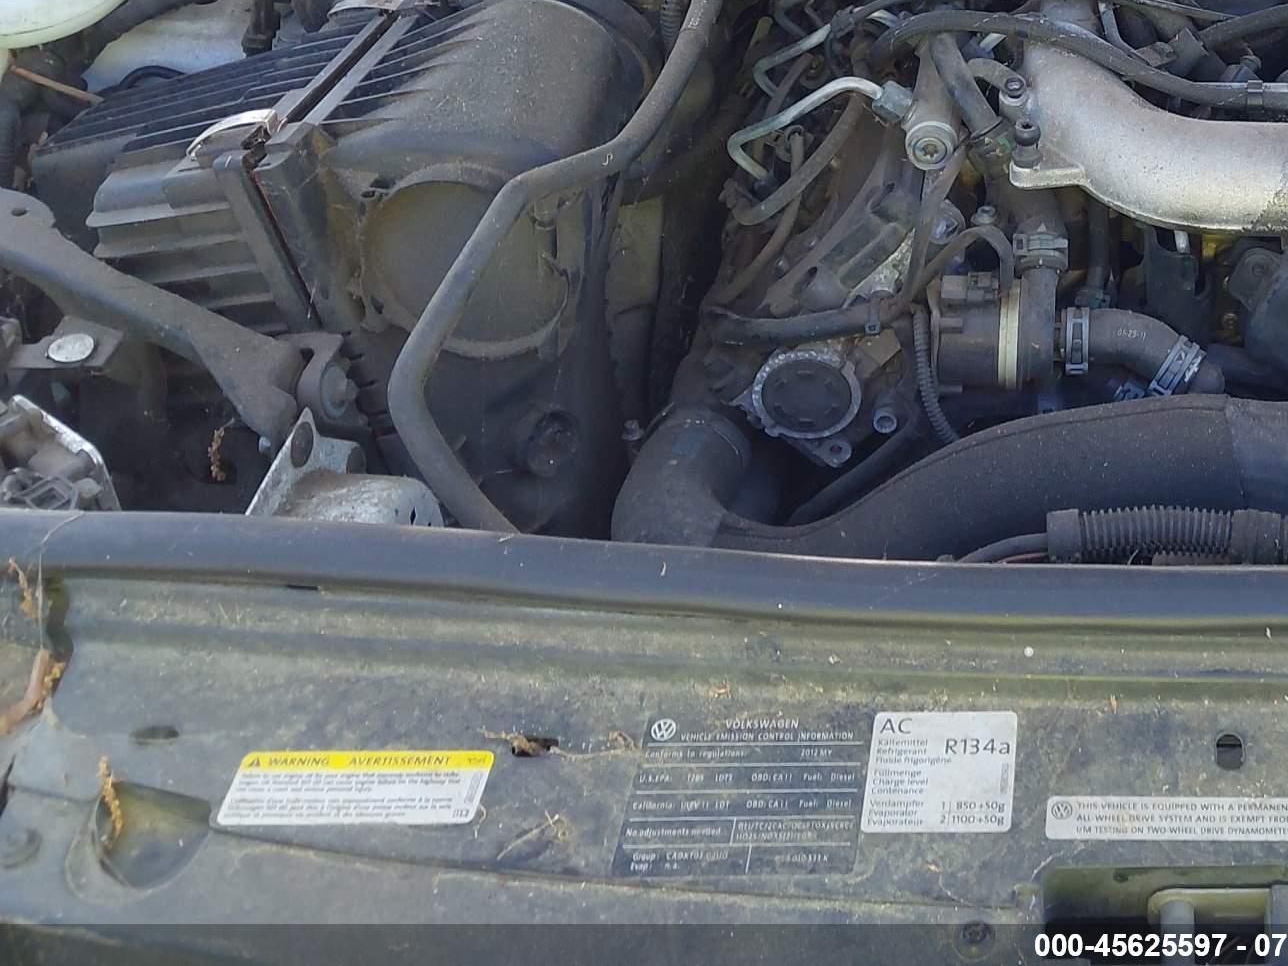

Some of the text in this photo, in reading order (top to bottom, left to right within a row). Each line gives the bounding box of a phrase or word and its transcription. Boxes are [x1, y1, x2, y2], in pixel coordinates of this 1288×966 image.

[726, 718, 799, 730] VOLKSWAGEN
[880, 718, 913, 734] AC
[757, 732, 794, 741] CONTROL
[798, 731, 854, 741] INFORMATION
[944, 738, 1010, 755] R134a
[687, 749, 696, 758] to
[268, 755, 450, 767] WARNING AVERTISSEMENT
[873, 777, 929, 788] Charge level
[1077, 802, 1098, 810] THIS
[1101, 802, 1137, 810] VEHICLE
[1141, 802, 1149, 810] IS
[1152, 802, 1197, 811] EQUIPPED
[1200, 803, 1225, 811] WITH
[1228, 803, 1235, 811] A
[940, 815, 946, 824] 2
[1159, 814, 1192, 823] SYSTEM
[1195, 815, 1216, 823] AND
[1220, 815, 1227, 823] IS
[1230, 815, 1265, 823] EXEMPT
[625, 828, 637, 838] No
[639, 827, 689, 839] adjustments
[1095, 826, 1128, 834] TESTING
[1131, 826, 1144, 834] ON
[1200, 826, 1225, 835] DRIVE
